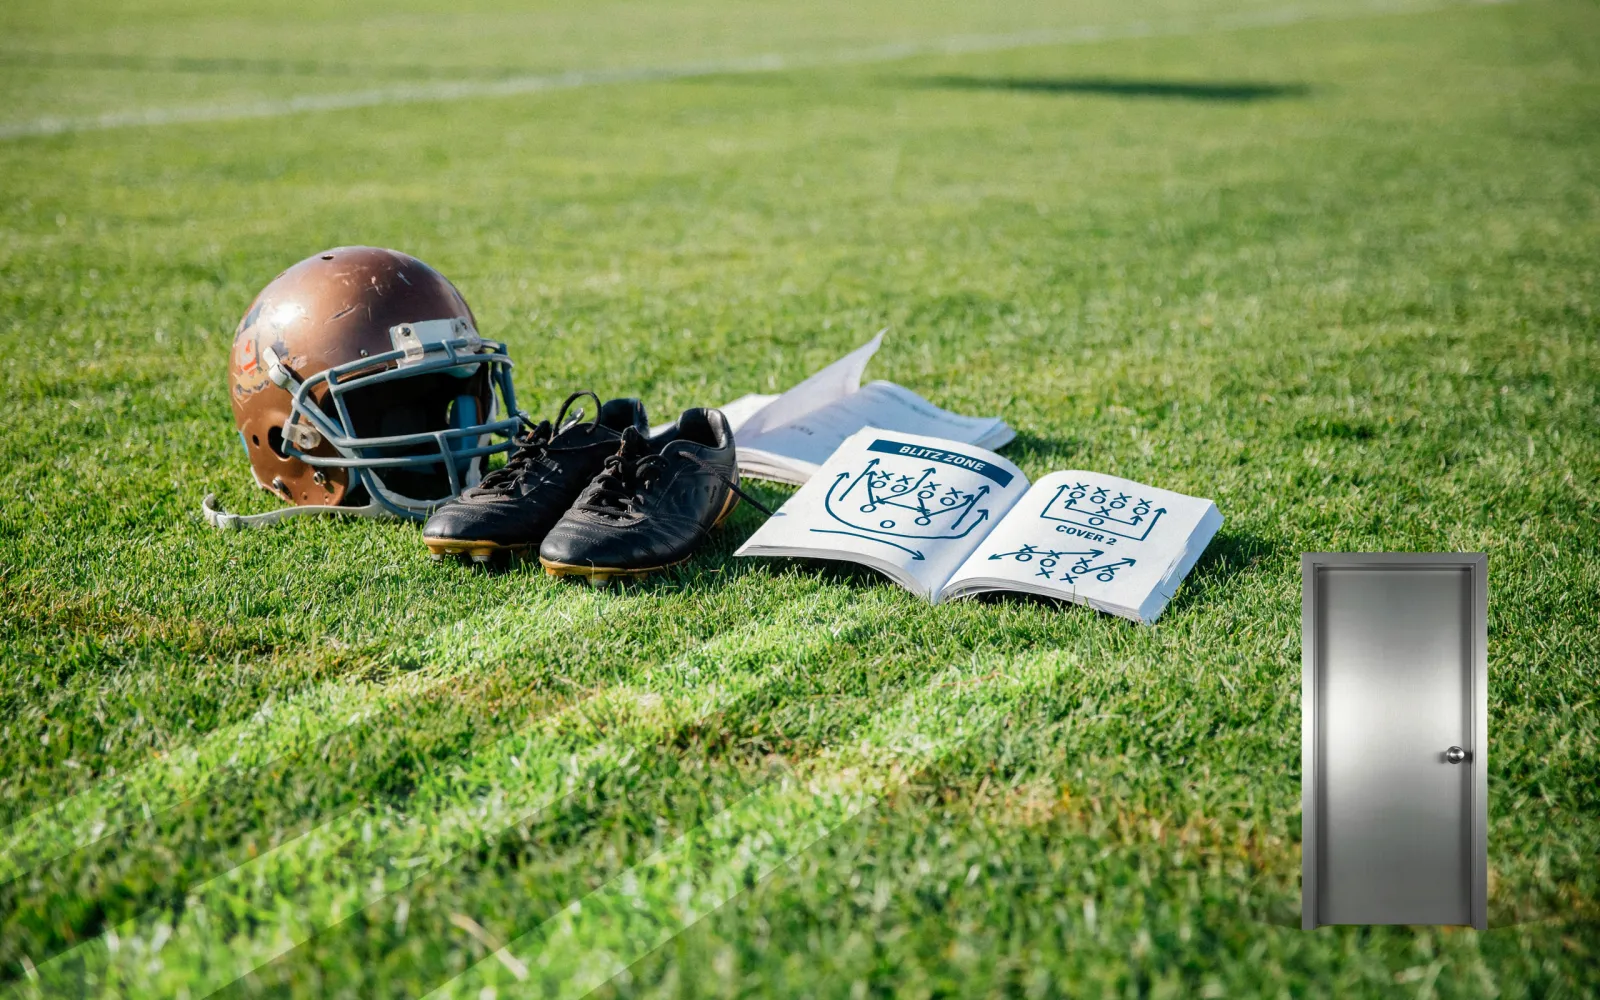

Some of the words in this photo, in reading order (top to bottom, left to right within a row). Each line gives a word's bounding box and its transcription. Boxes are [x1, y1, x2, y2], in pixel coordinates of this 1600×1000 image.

[899, 445, 943, 460] BLITZ
[942, 454, 986, 471] ZONE
[1055, 524, 1105, 543] COVER
[1105, 537, 1118, 546] 2
